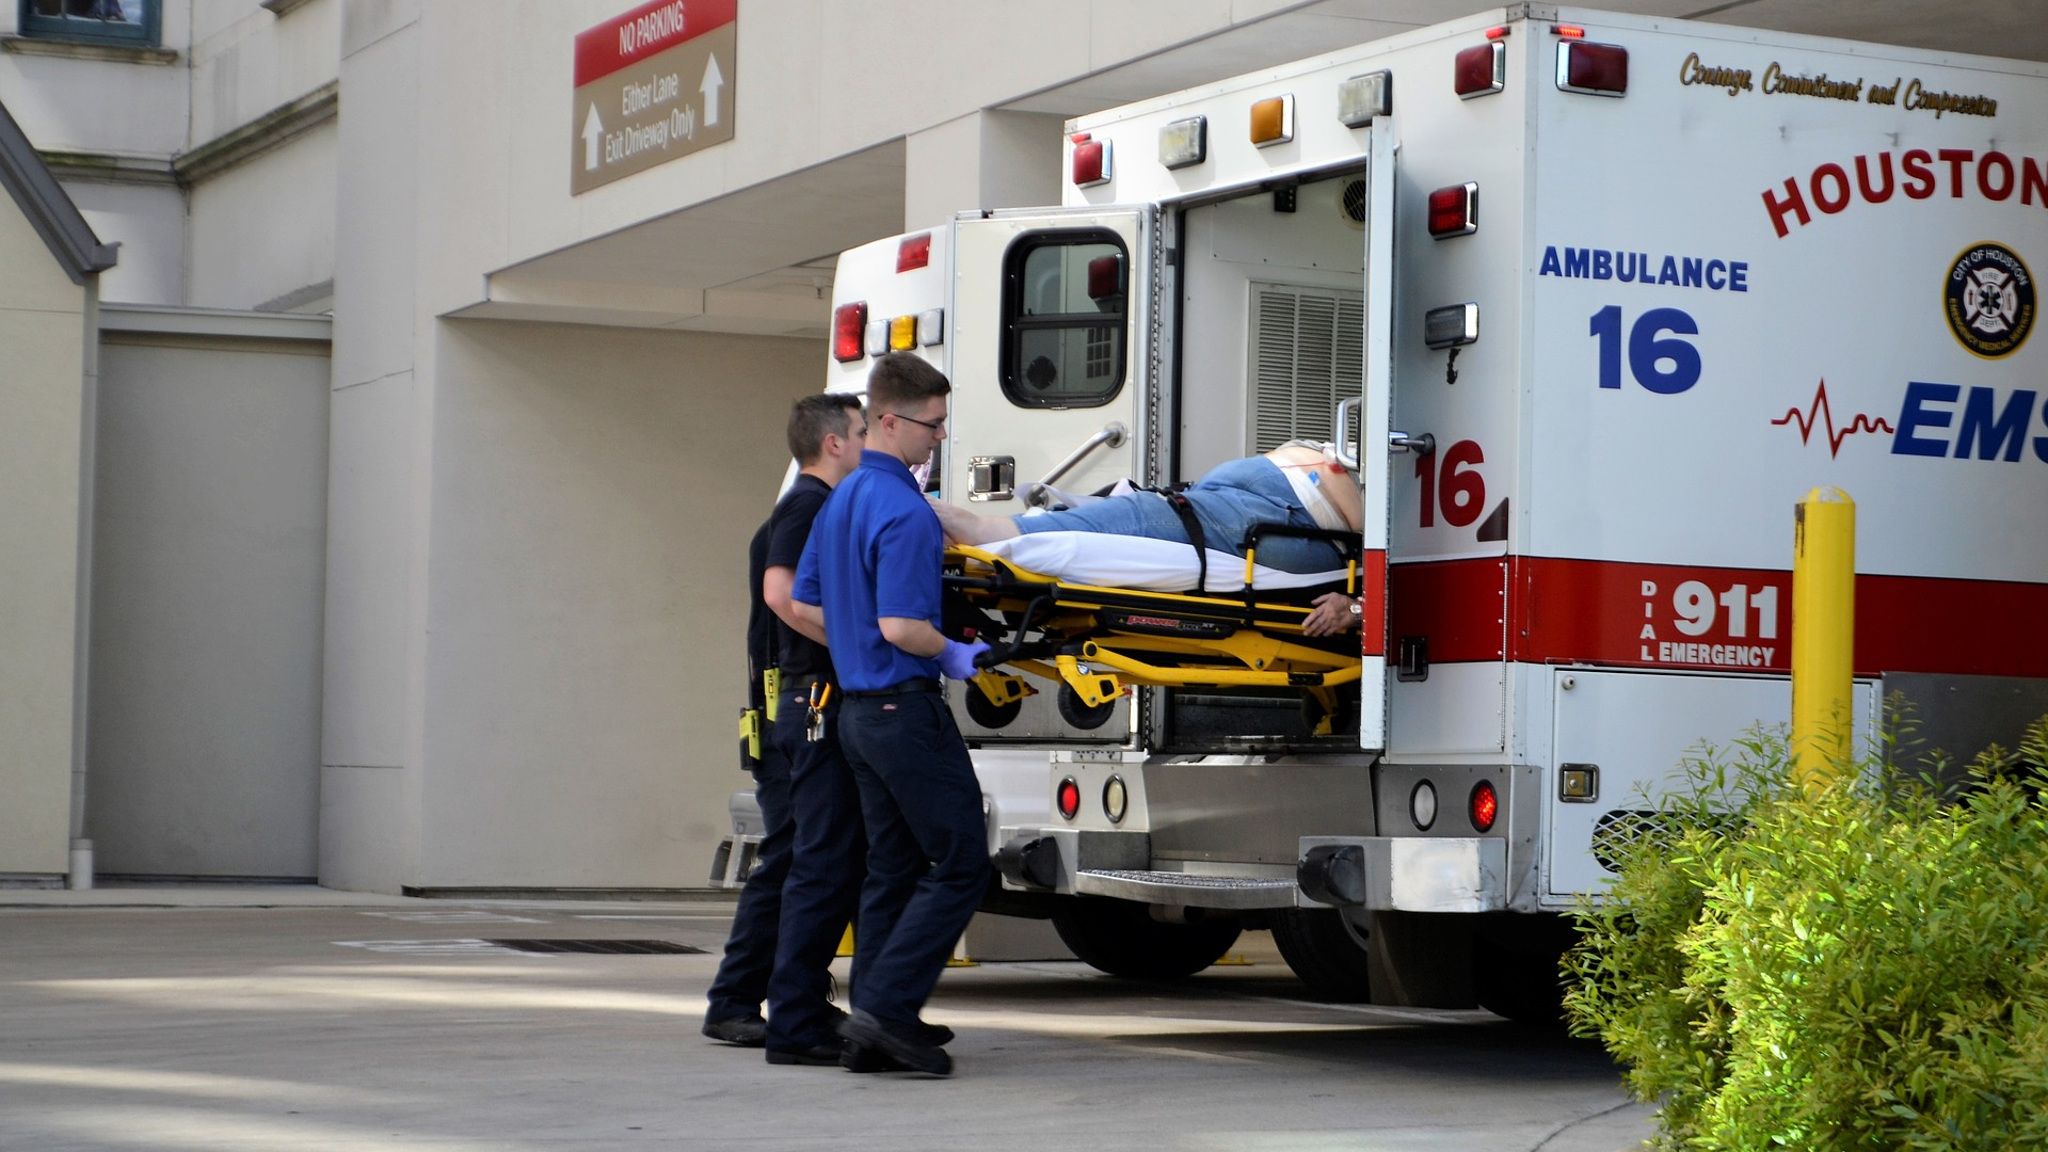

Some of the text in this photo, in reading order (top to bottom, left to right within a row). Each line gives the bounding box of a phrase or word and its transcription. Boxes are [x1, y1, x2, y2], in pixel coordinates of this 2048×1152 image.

[619, 0, 684, 56] NO PARKING
[622, 73, 679, 116] Either Lane
[1761, 61, 1863, 102] Commitment
[1867, 77, 1901, 105] and
[1903, 77, 1998, 120] Compassion
[605, 104, 695, 163] Exit Driveway Only
[1760, 149, 2048, 239] HOUSTON
[1539, 245, 1748, 292] AMBULANCE
[1952, 248, 2029, 286] CITY OF HOUSTON
[1589, 305, 1702, 395] 16
[1414, 438, 1486, 528] 16
[1639, 580, 1658, 661] DIAL
[1673, 580, 1778, 639] 911
[1659, 641, 1775, 667] EMERGENCY
